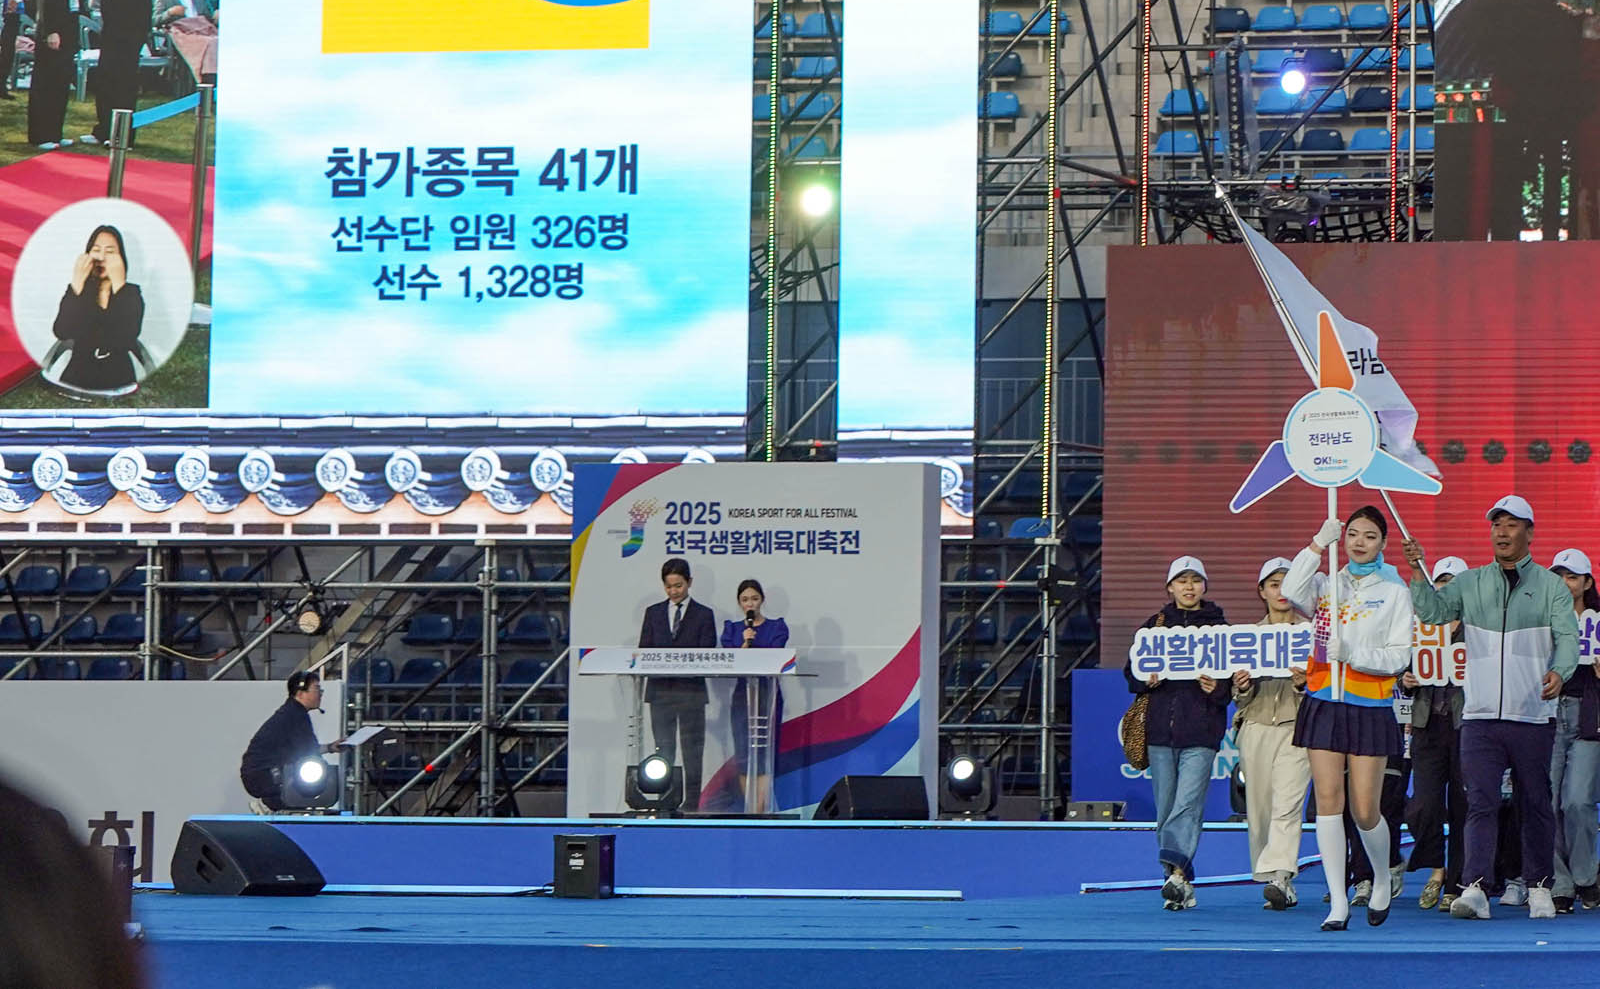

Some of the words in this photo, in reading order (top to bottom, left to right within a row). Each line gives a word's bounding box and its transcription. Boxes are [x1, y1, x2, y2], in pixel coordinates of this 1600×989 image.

[324, 146, 520, 198] 참가종목
[538, 143, 639, 195] 41개
[331, 215, 434, 253] 선수단
[449, 213, 516, 252] 임원
[531, 212, 630, 251] 326명
[372, 263, 442, 302] 선수
[457, 261, 585, 303] 1,328명
[1347, 347, 1385, 376] 라남
[1308, 431, 1353, 447] 전라남도
[665, 501, 722, 525] 2025
[728, 507, 756, 518] KOREA
[757, 507, 784, 519] SPORT
[786, 507, 803, 518] FOR
[804, 507, 819, 518] ALL
[820, 507, 858, 519] FESTIVAL
[664, 529, 861, 555] 전국생활체육대축전
[641, 652, 662, 662] 2025
[664, 652, 735, 663] 전국생활체육대축전
